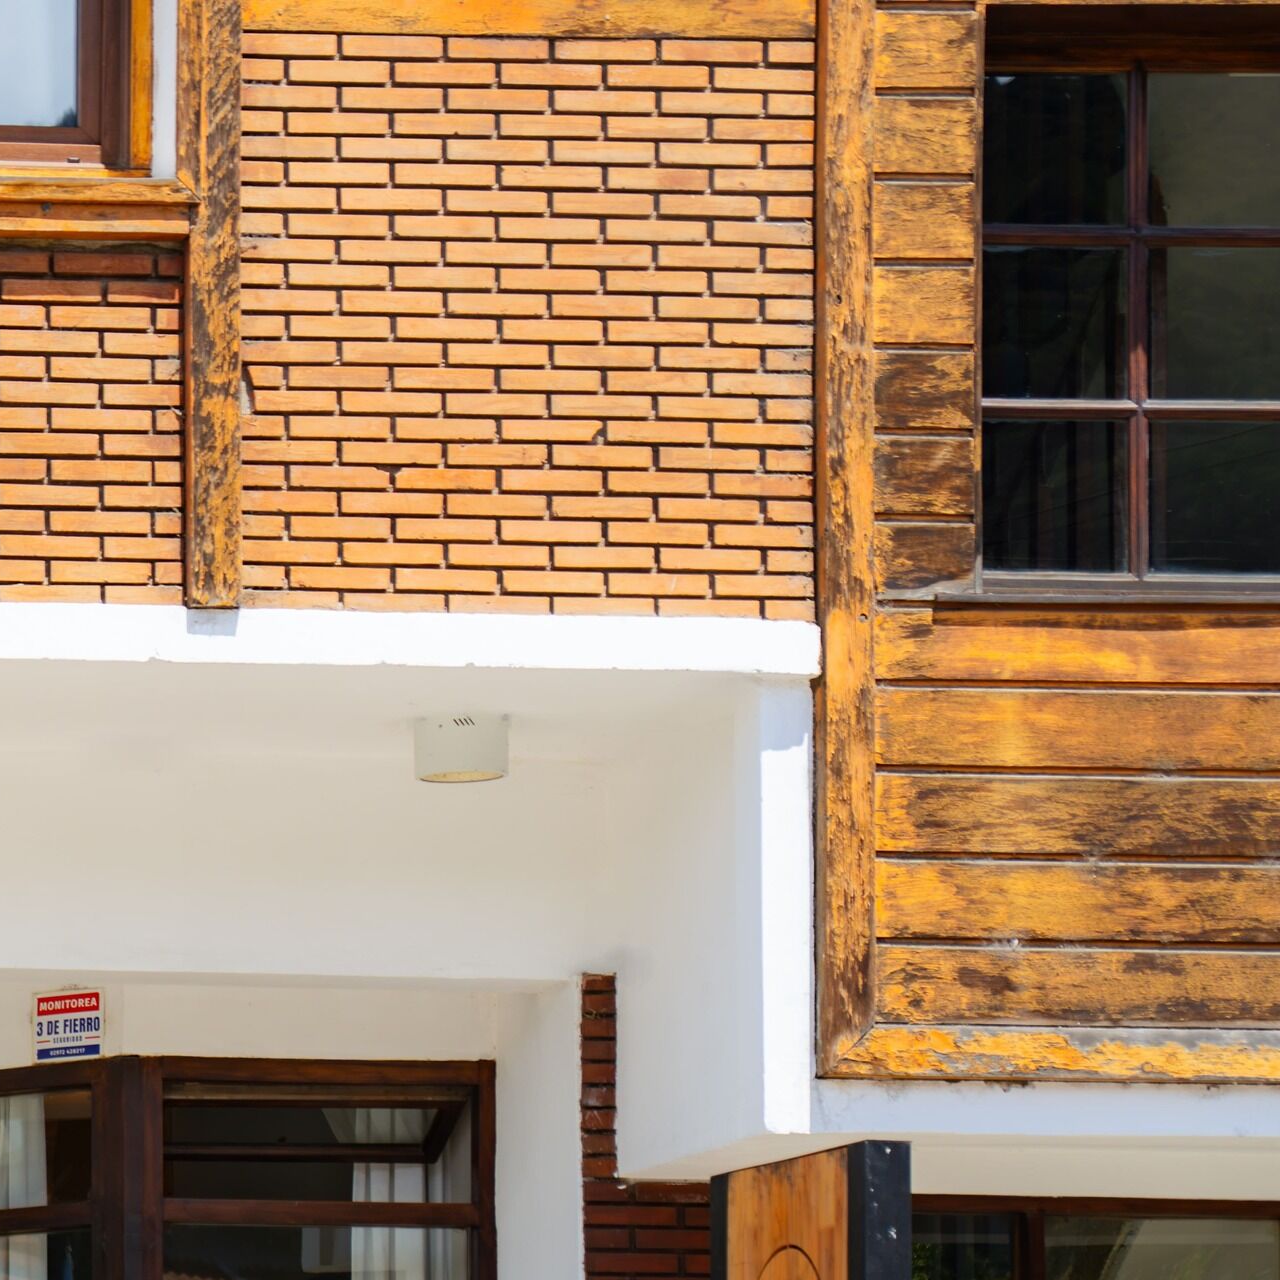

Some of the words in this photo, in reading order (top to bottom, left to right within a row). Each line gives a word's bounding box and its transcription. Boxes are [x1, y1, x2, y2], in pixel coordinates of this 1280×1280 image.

[40, 997, 97, 1011] MONITOREA
[37, 1022, 43, 1036] 3
[47, 1021, 59, 1035] DE
[63, 1016, 100, 1034] FIERRO
